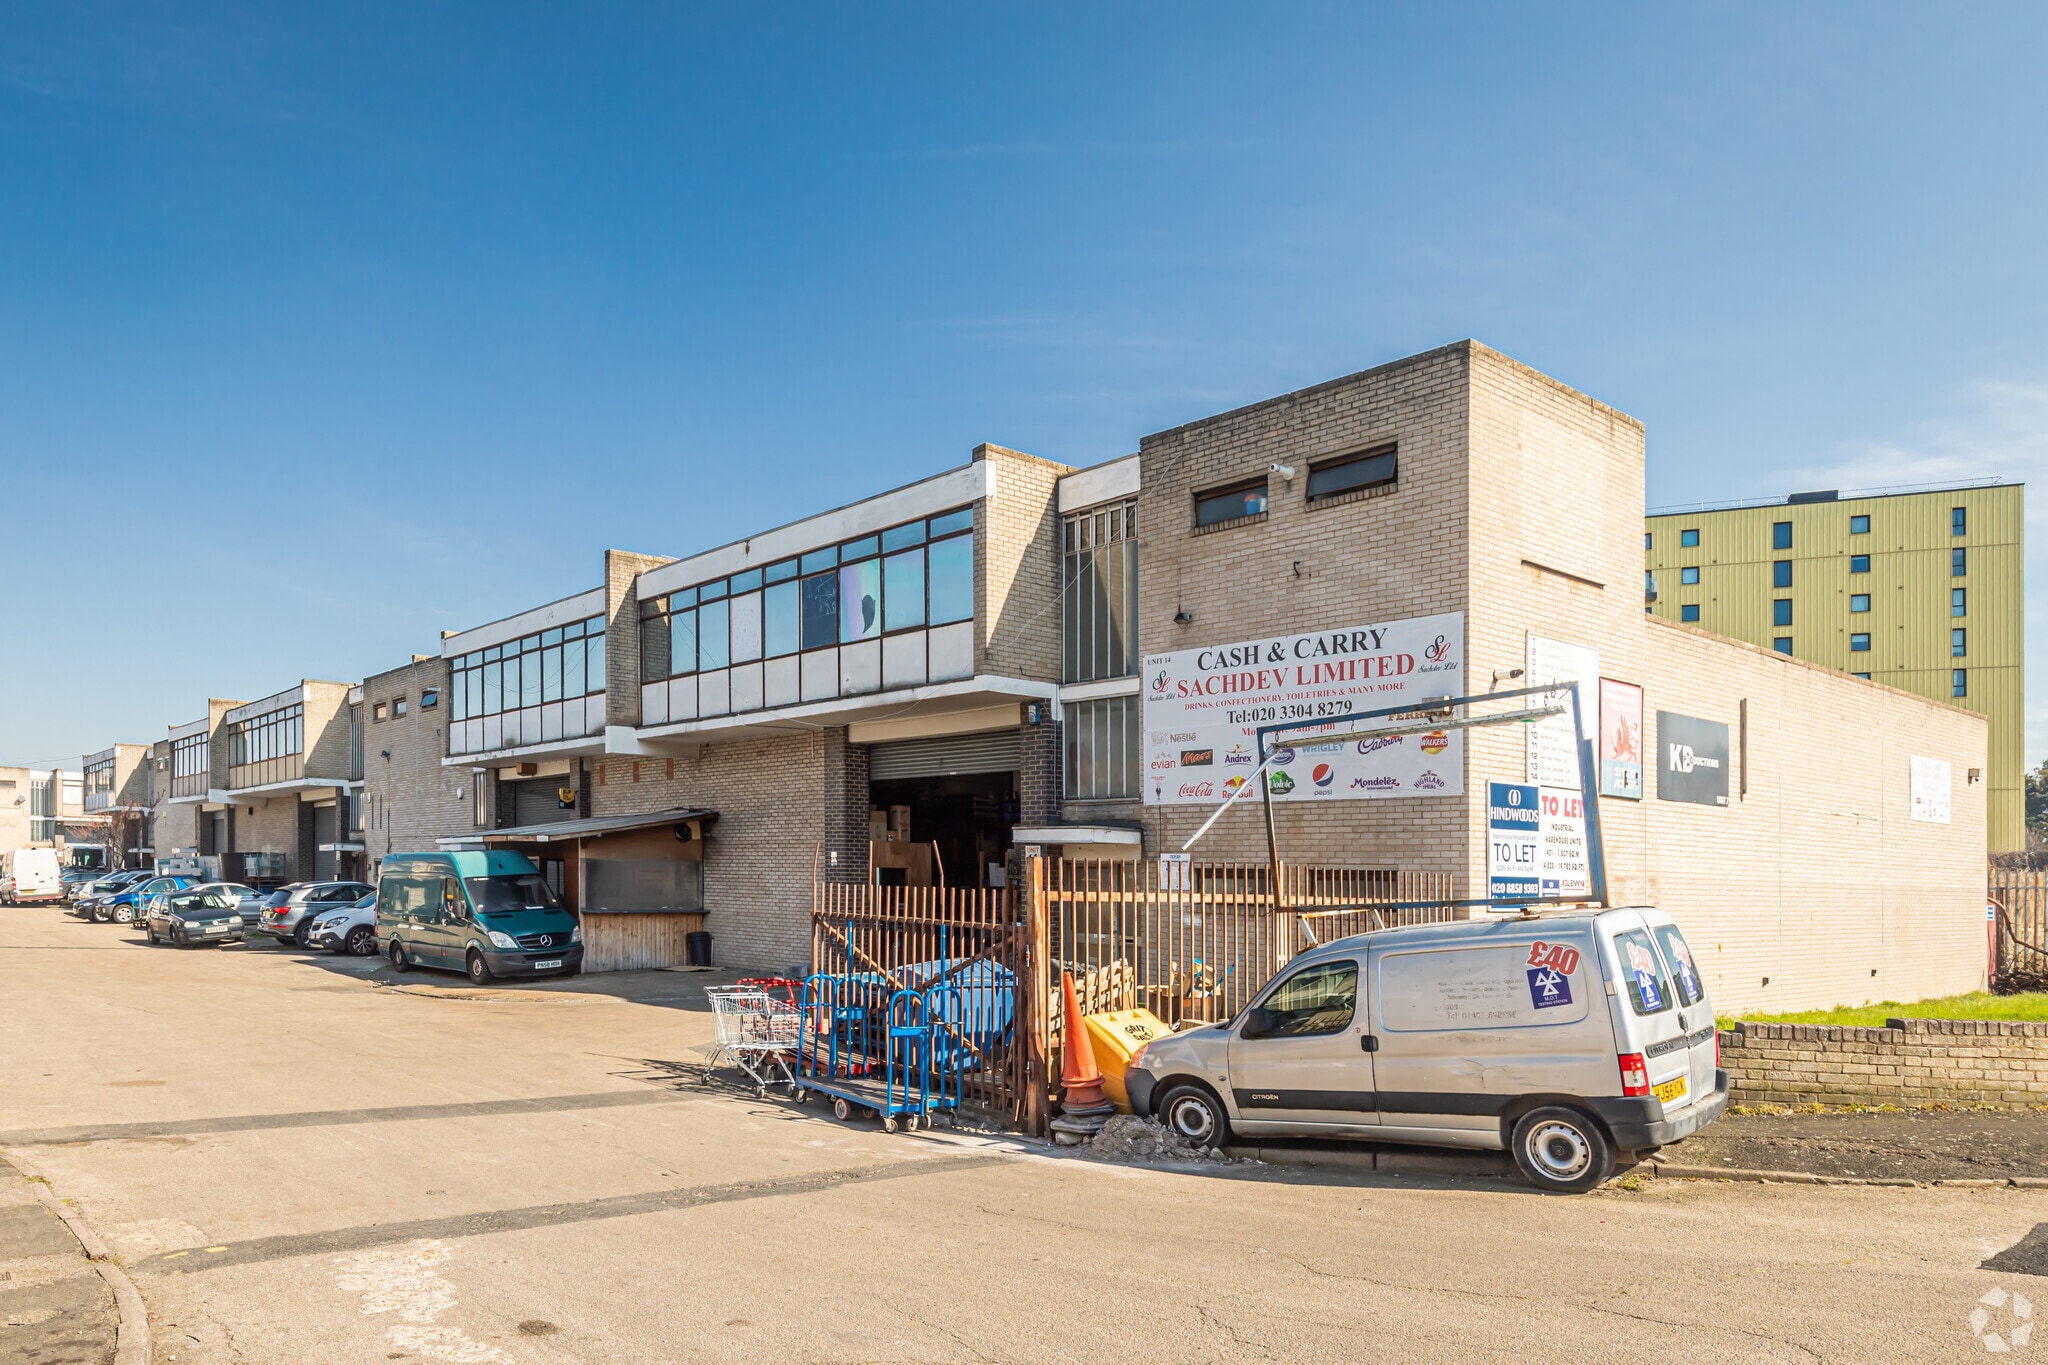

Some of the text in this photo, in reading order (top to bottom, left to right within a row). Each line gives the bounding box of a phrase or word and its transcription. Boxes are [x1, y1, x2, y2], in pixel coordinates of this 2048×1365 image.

[1197, 628, 1388, 671] CASH & CARRY
[1147, 656, 1171, 666] UNIT 14
[1177, 653, 1415, 699] SACHDEV LIMITED
[1286, 688, 1336, 701] TOILETRIES
[1338, 687, 1345, 696] &
[1347, 685, 1375, 695] MANY
[1377, 681, 1406, 691] MORE
[1279, 703, 1313, 720] 3304
[1318, 700, 1353, 717] 8279
[1530, 731, 1538, 739] 10
[1357, 735, 1403, 755] Cadbury
[1420, 736, 1448, 747] WALKERS
[1531, 741, 1538, 749] 11
[1302, 742, 1345, 753] WRIGLEY
[1181, 750, 1212, 766] Mars
[1224, 754, 1252, 763] Andrex
[1530, 752, 1538, 760] 12
[1150, 759, 1176, 770] evian
[1530, 762, 1538, 770] 13
[1530, 772, 1538, 780] 14
[1413, 776, 1445, 789] HIGHLAND
[1541, 795, 1584, 819] TO LET
[1490, 807, 1539, 823] HINDWOODS
[1550, 823, 1574, 832] INDUSTRIAL
[1545, 835, 1581, 845] WAREHOUSE UNITS
[1493, 842, 1537, 863] TO LET
[1492, 882, 1505, 894] 020
[1523, 883, 1538, 894] 9303
[1564, 879, 1582, 887] GLENNY
[1526, 941, 1580, 975] £40
[1125, 1024, 1145, 1034] GRIT
